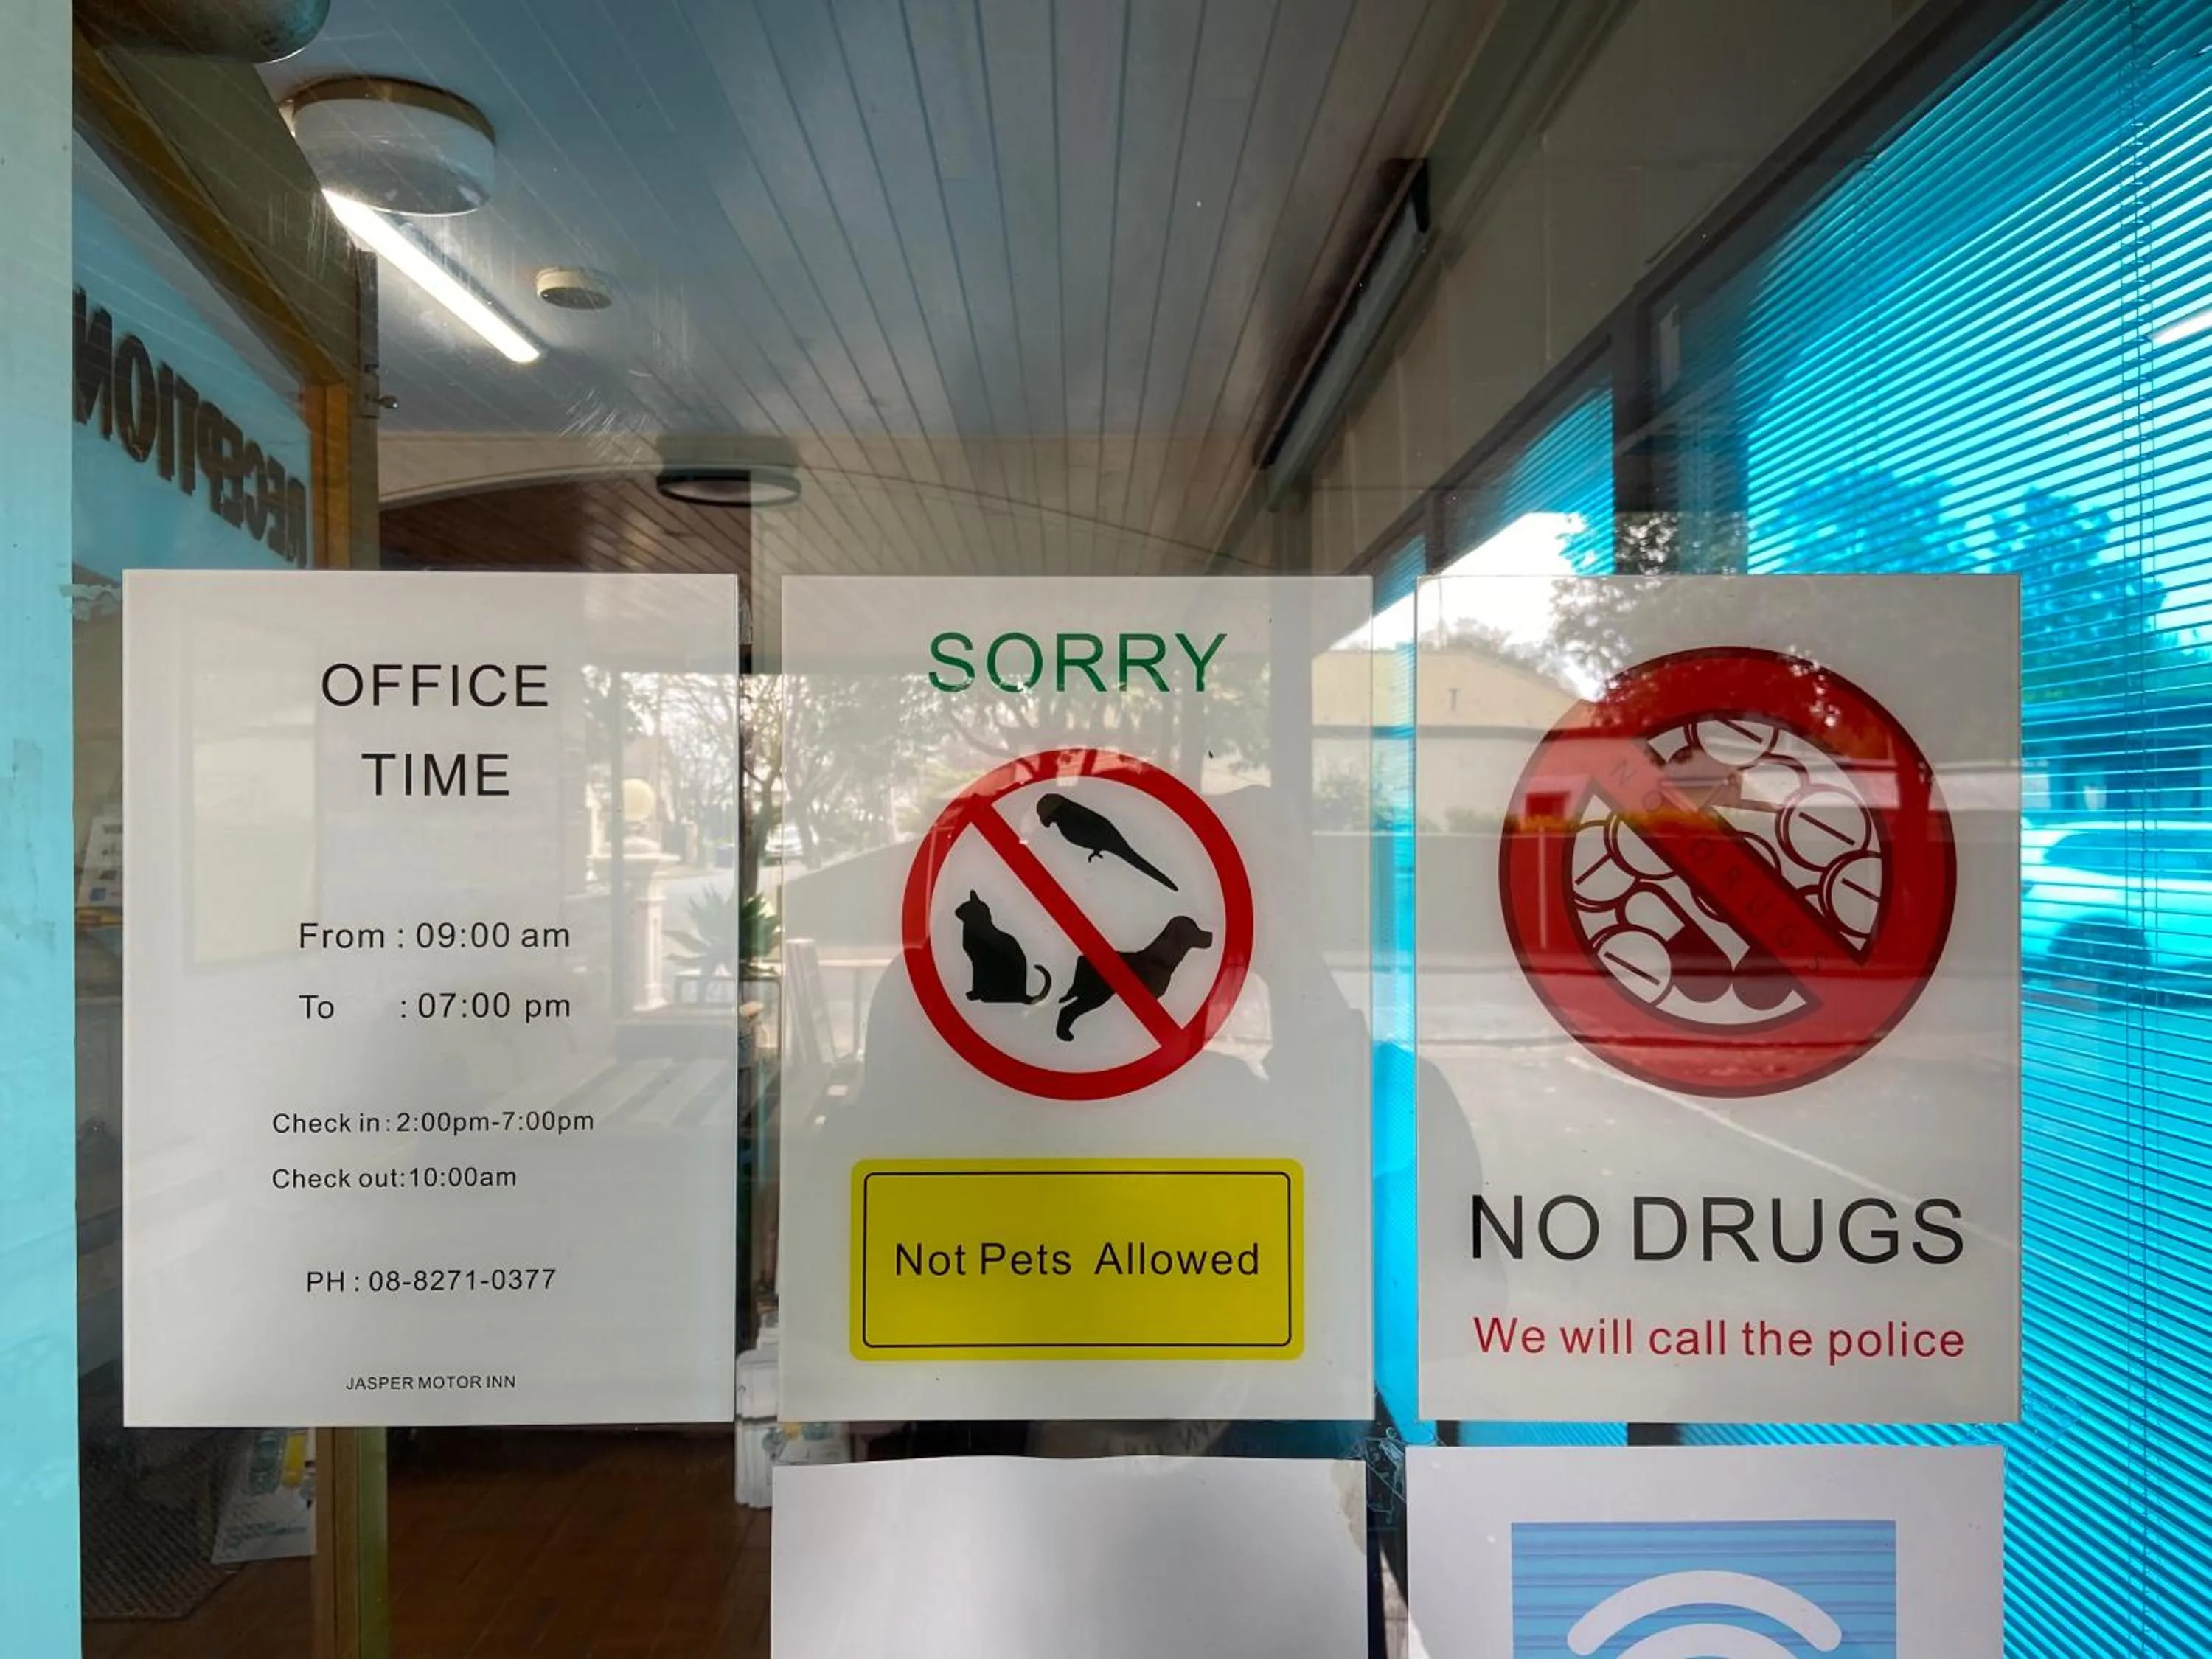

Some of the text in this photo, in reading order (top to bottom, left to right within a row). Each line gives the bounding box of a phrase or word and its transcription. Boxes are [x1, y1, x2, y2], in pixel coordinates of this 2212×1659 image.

[928, 632, 1228, 692] SORRY
[321, 663, 549, 707] OFFICE
[361, 753, 509, 796] TIME
[1610, 755, 1829, 972] NO DRUGS
[299, 922, 385, 949] From
[416, 922, 509, 949] 09:00
[521, 928, 569, 948] am
[299, 995, 335, 1020] To
[418, 992, 511, 1018] 07:00
[526, 999, 570, 1024] pm
[272, 1113, 352, 1133] Check
[397, 1110, 594, 1136] 2:00pm-7:00pm
[272, 1168, 352, 1189] Check
[1472, 1194, 1964, 1265] NO DRUGS
[896, 1242, 1259, 1276] Not Pets Allowed
[307, 1270, 344, 1293] PH
[369, 1268, 556, 1292] 08-8271-0377
[1473, 1316, 1964, 1366] We will call the police
[346, 1375, 515, 1390] JASPER MOTOR INN
